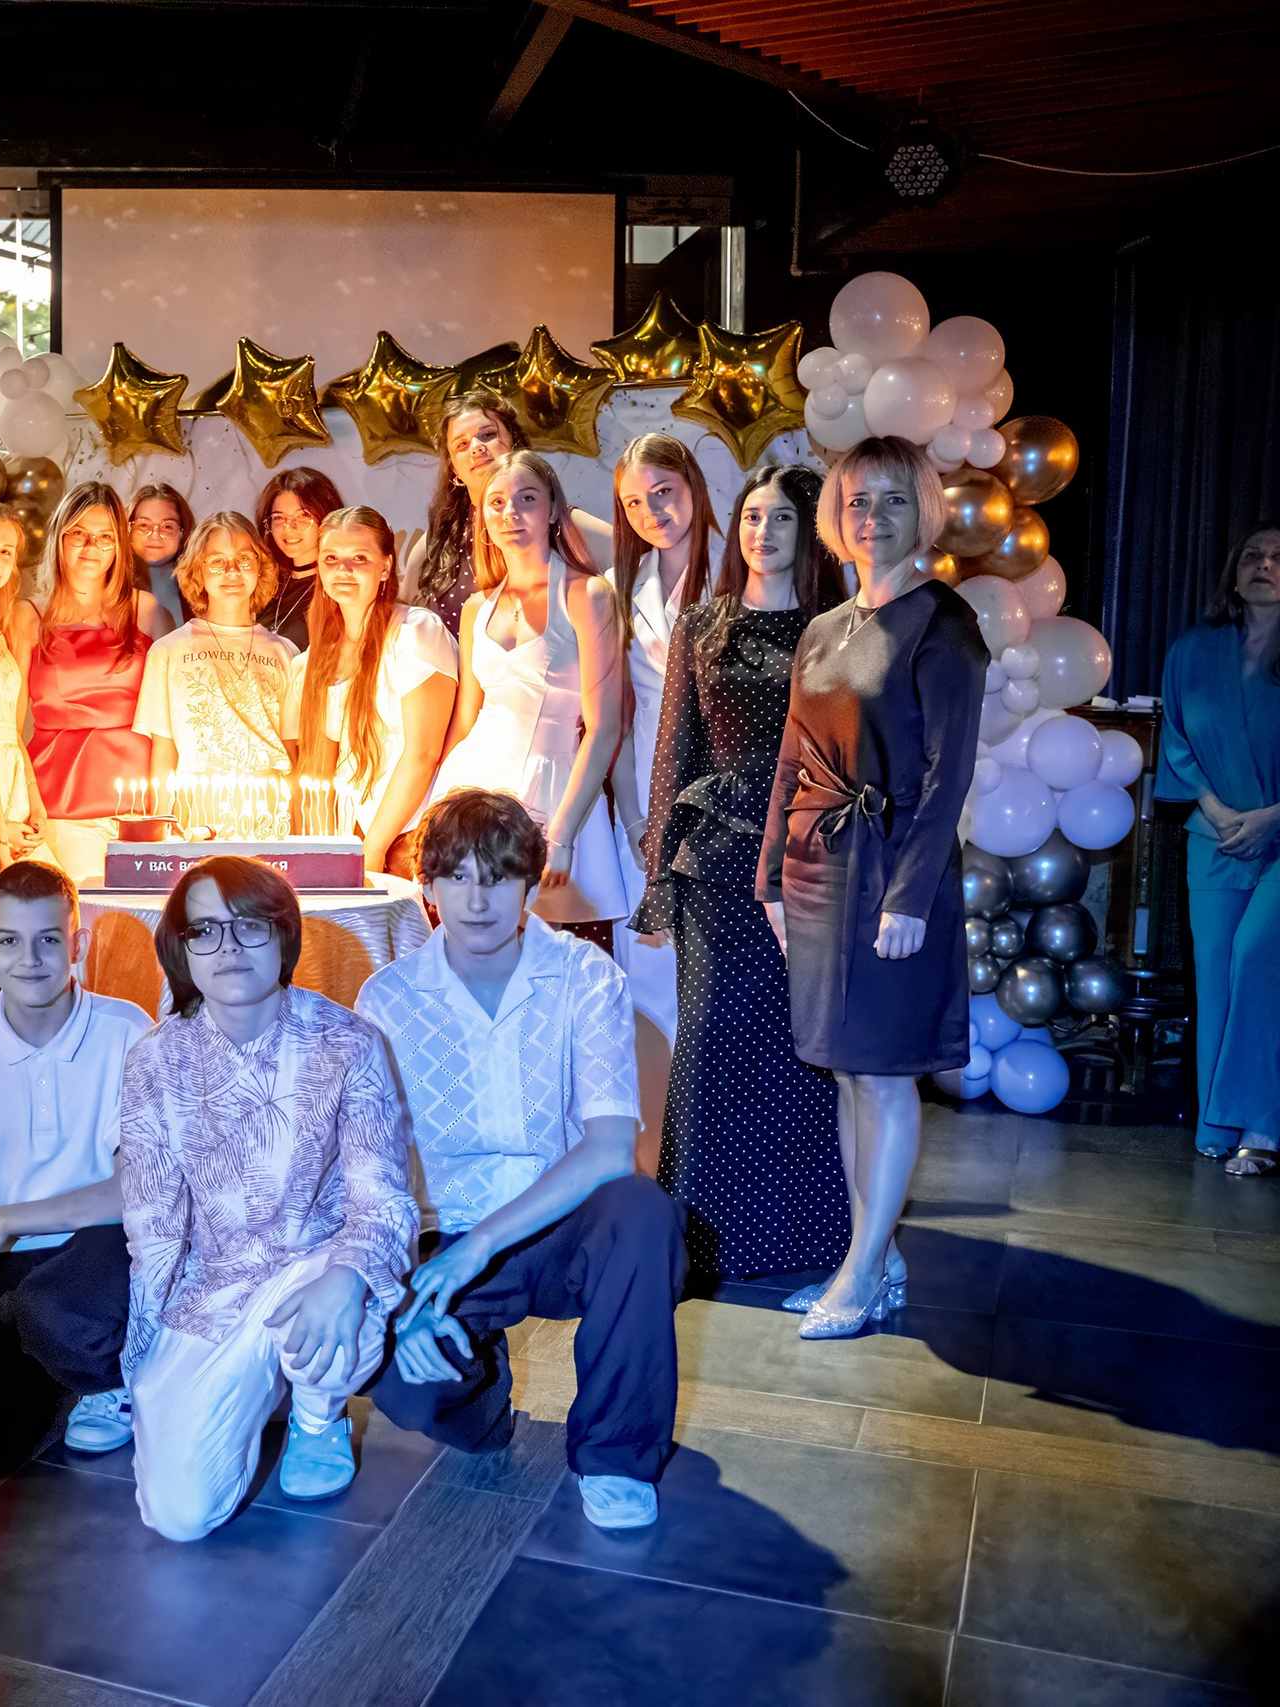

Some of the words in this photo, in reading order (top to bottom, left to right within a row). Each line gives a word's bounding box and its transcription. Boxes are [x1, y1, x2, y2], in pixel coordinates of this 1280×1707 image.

[183, 650, 235, 663] FLOWER
[240, 652, 282, 669] MARKE
[134, 860, 143, 871] У
[149, 861, 174, 872] ВАС
